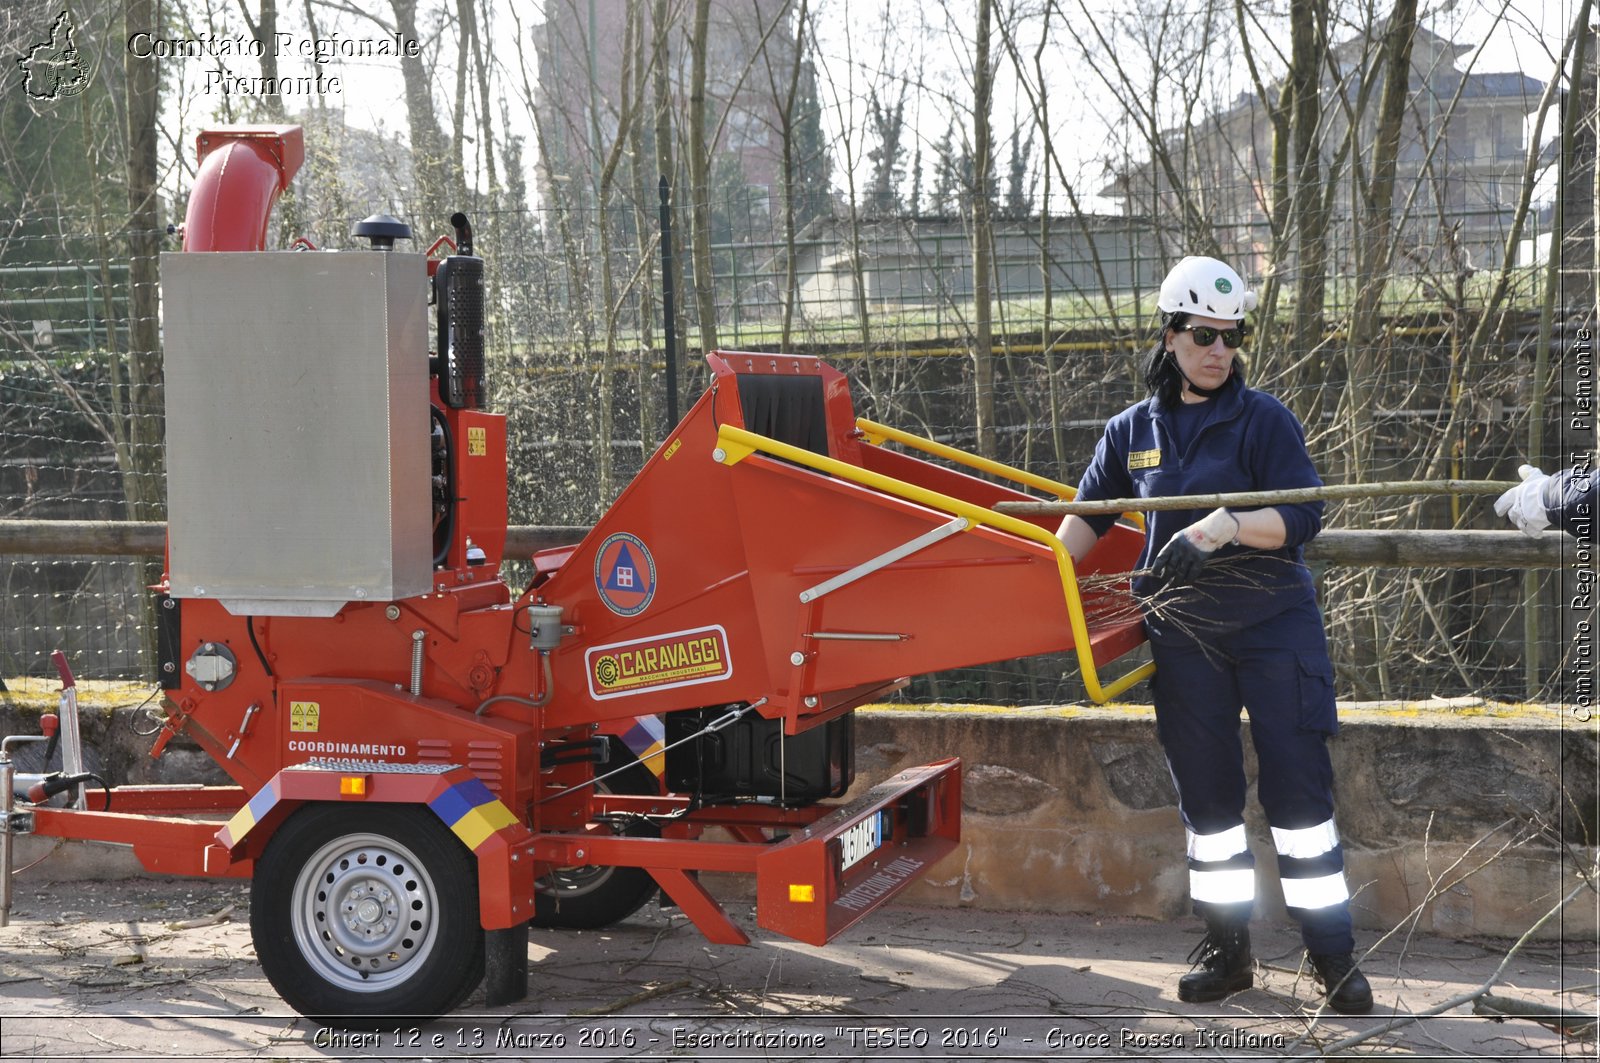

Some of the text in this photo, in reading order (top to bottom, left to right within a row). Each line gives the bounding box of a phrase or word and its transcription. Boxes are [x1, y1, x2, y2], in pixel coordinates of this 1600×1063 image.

[620, 637, 720, 676] CARAVAGGI
[639, 667, 706, 681] MACCHINE INDUSTRIALI
[288, 740, 406, 756] COORDINAMENTO
[834, 855, 924, 911] PROTEZIONE CIVILE
